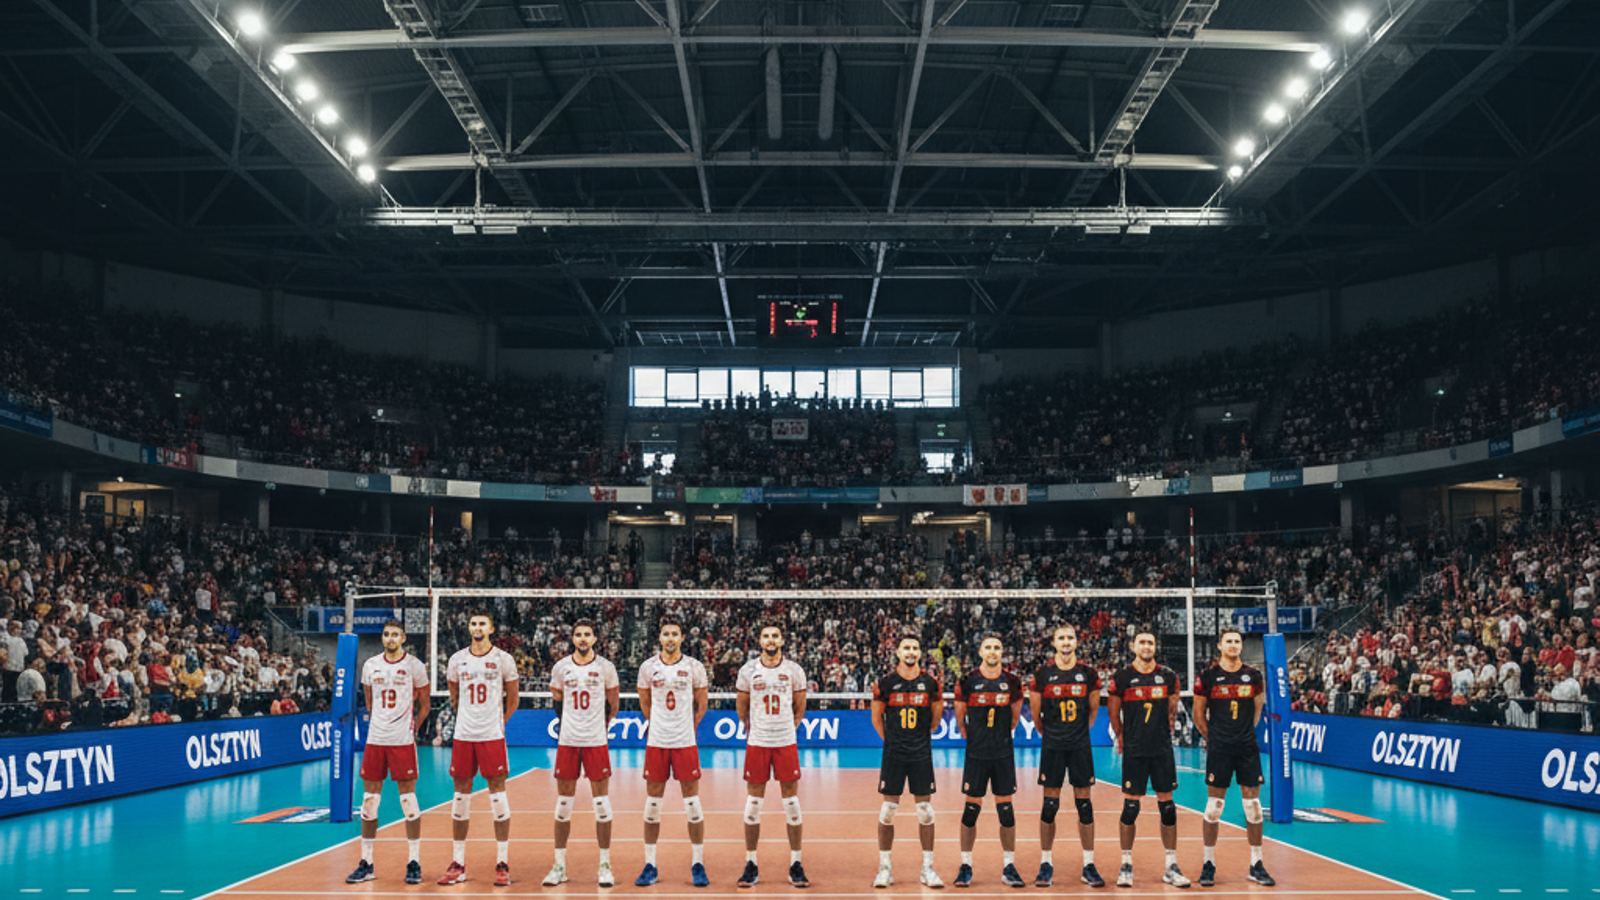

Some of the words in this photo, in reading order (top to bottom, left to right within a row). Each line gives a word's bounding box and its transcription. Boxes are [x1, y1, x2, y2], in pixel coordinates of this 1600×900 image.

[186, 728, 262, 769] OLSZTYN
[1372, 731, 1461, 773] OLSZTYN
[1541, 748, 1600, 794] OLS
